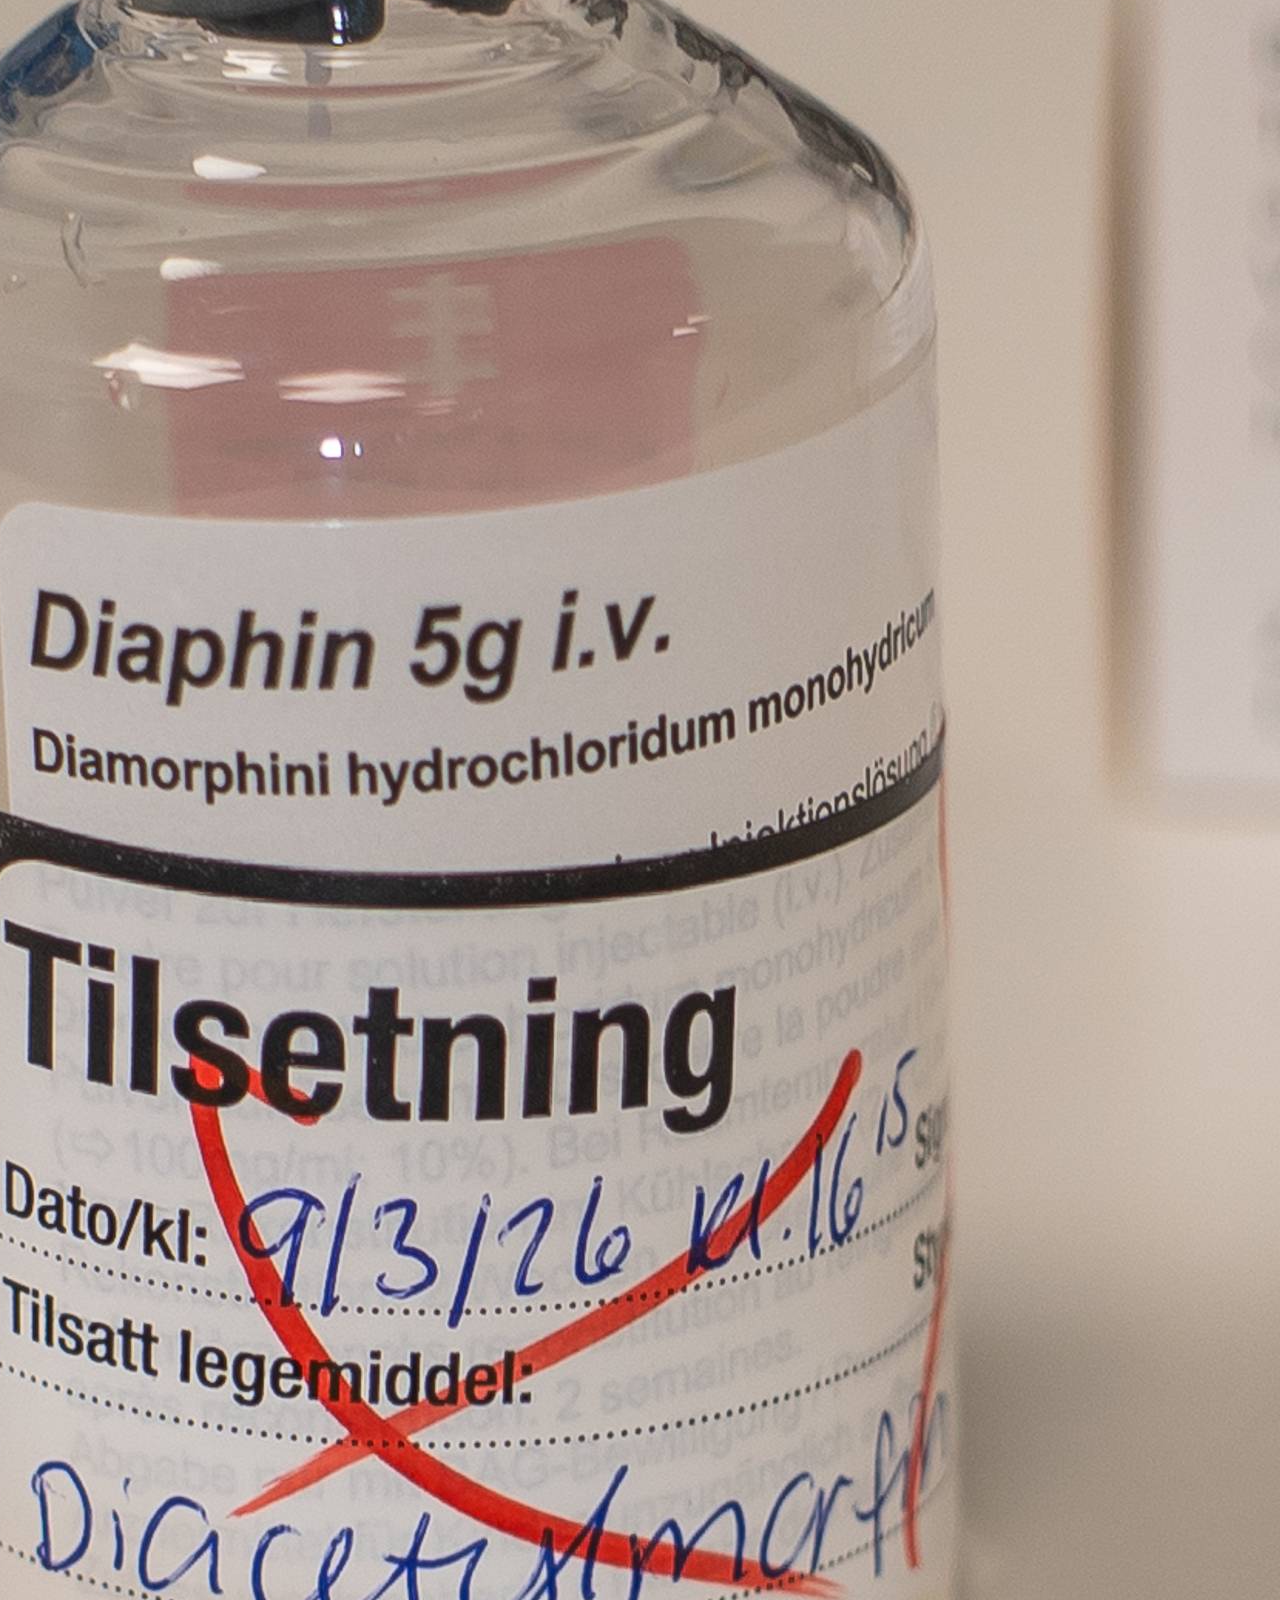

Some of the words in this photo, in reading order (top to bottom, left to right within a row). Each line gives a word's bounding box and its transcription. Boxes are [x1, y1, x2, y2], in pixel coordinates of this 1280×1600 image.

[29, 588, 375, 707] Diaphin
[409, 603, 523, 704] 5g
[550, 588, 672, 674] i.v.
[32, 726, 330, 805] Diamorphini
[347, 707, 736, 807] hydrochloridum
[3, 919, 737, 1134] Tilsetning
[4, 1159, 208, 1268] Dato/kl:
[238, 1173, 632, 1328] 9/3/26
[1, 1276, 160, 1378] Tilsatt
[179, 1325, 534, 1408] legemiddel:
